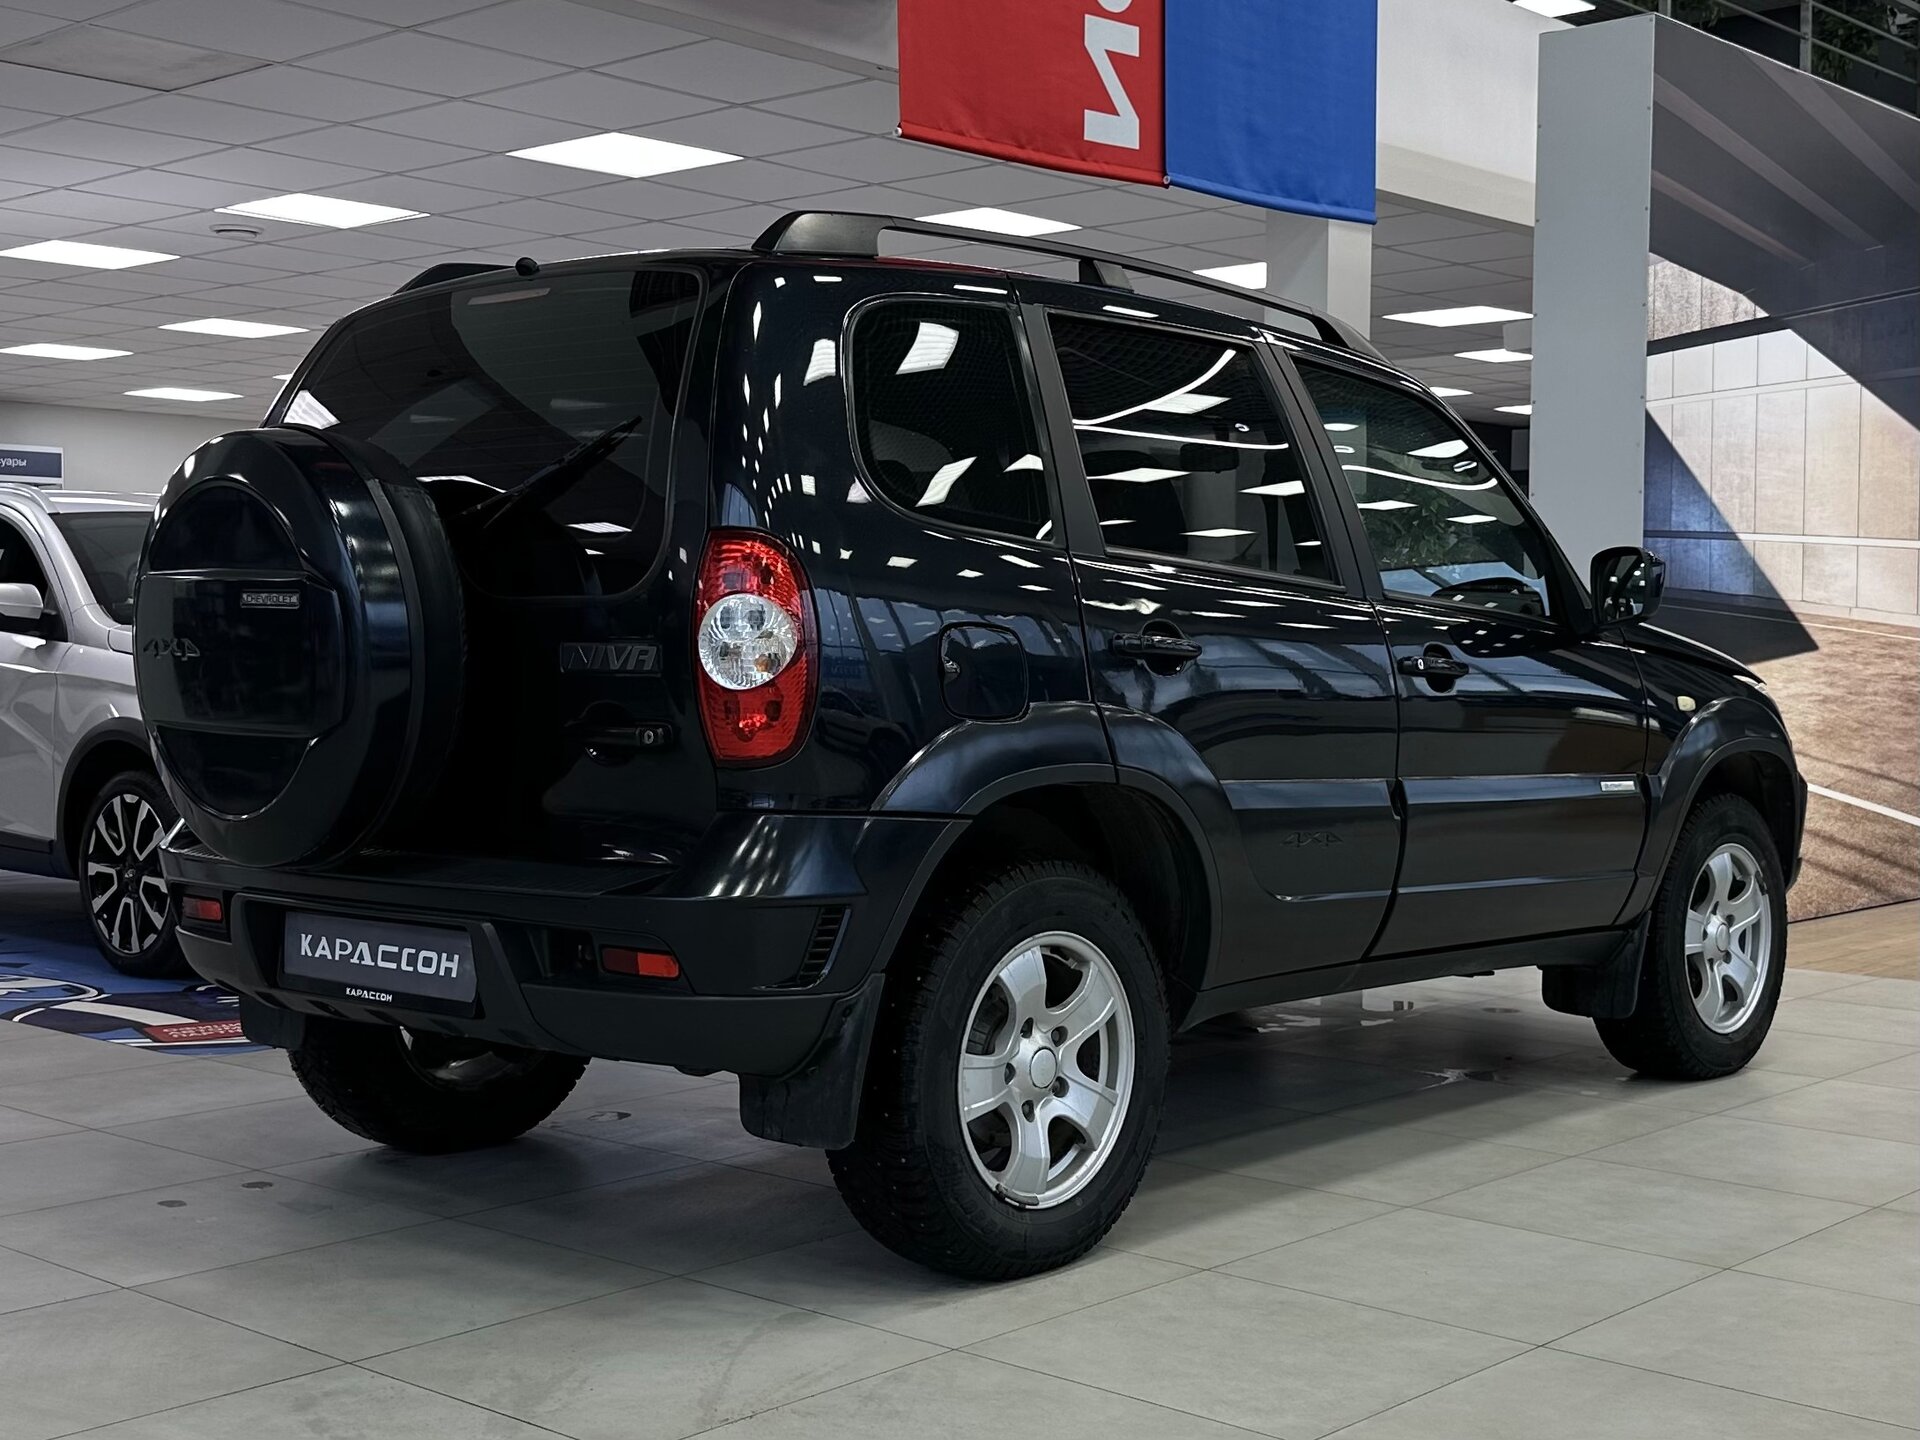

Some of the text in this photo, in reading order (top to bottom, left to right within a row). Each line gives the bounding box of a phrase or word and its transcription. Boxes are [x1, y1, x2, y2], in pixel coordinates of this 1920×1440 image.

[0, 457, 27, 468] уары
[244, 592, 295, 605] CHEVROLET
[566, 645, 658, 671] NIVA
